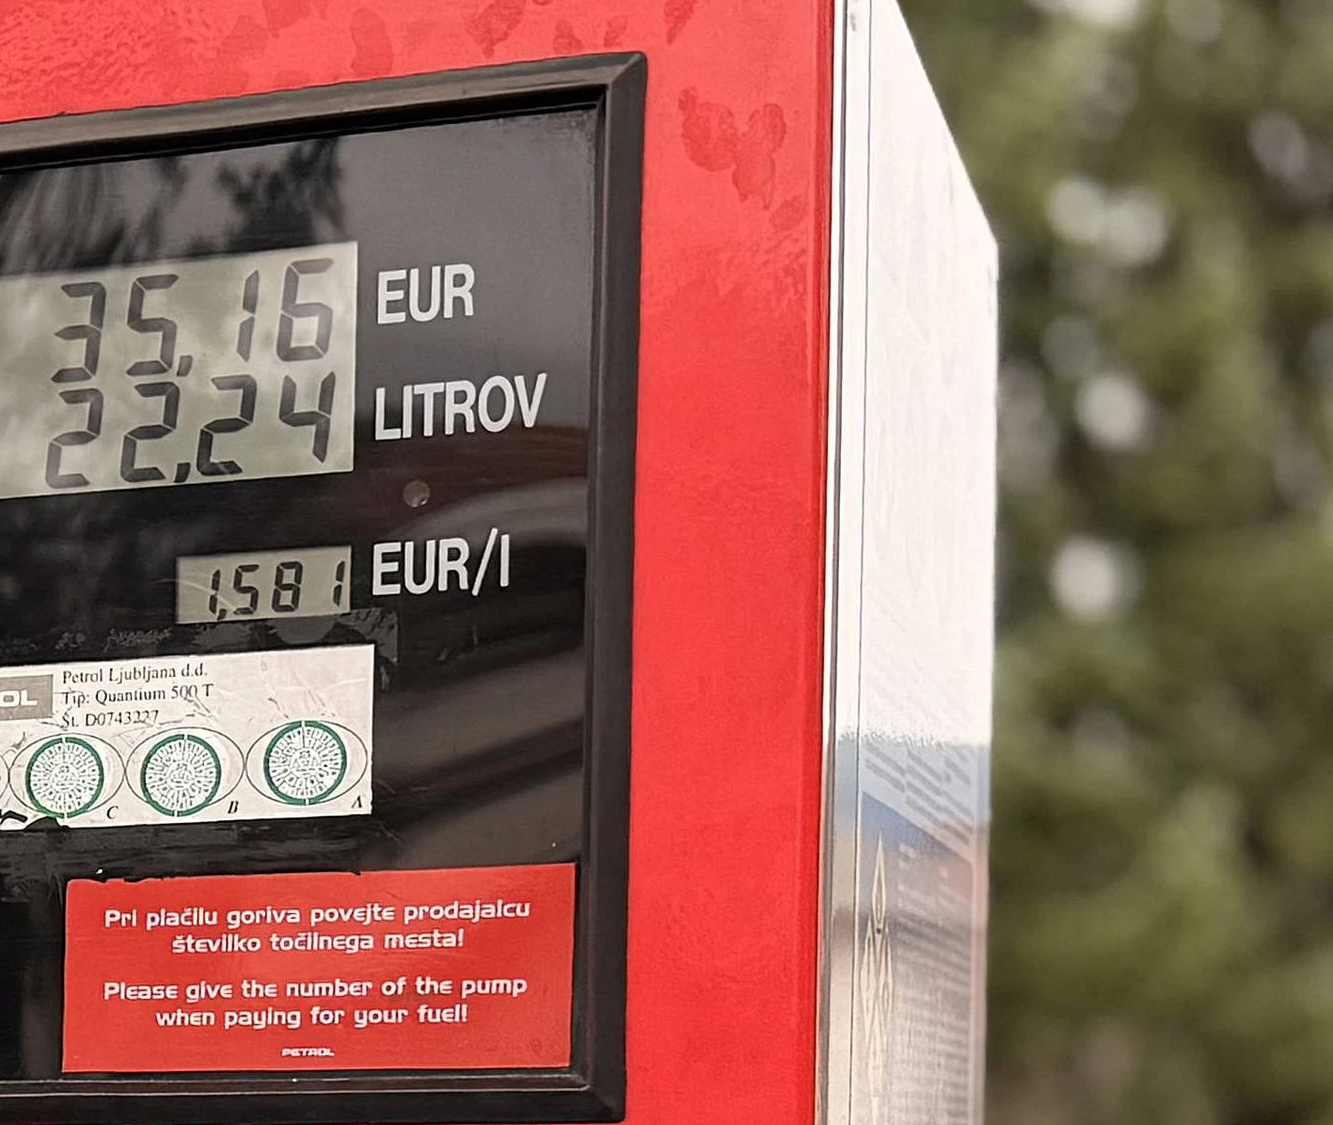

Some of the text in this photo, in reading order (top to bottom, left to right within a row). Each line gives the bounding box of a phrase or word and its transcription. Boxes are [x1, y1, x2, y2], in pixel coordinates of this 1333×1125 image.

[377, 264, 475, 326] EUR
[374, 373, 548, 441] LITROV
[63, 662, 208, 684] Petrol Ljubljana d.d.
[62, 683, 214, 708] Tip: Quantium 500 T
[104, 899, 531, 932] Pri plačilu goriva povejte prodajalcu
[171, 929, 465, 955] številko točilnega mesta!
[103, 976, 528, 1004] Please give the number of the pump
[155, 1003, 469, 1031] when paying for your fuel!
